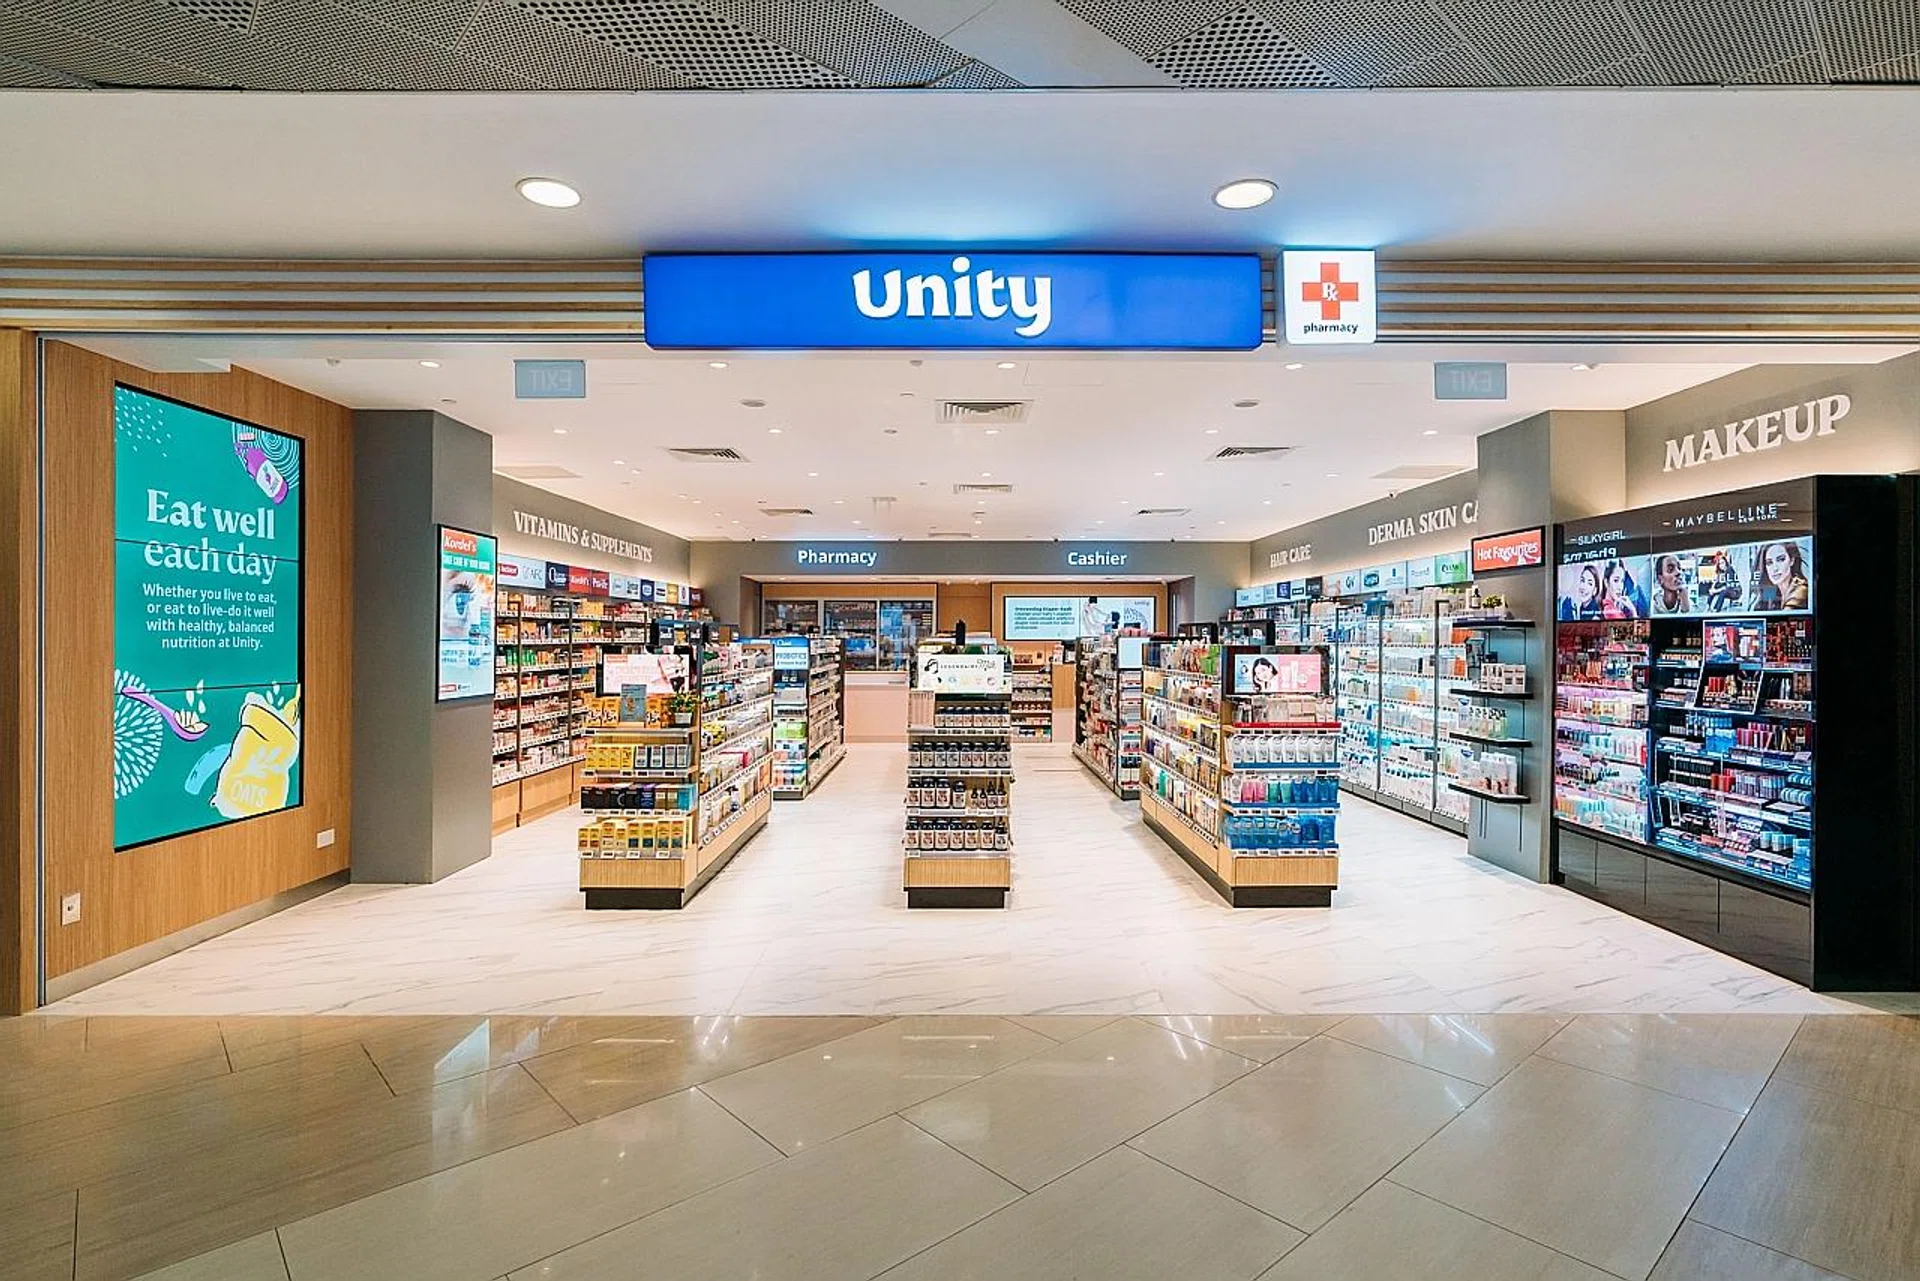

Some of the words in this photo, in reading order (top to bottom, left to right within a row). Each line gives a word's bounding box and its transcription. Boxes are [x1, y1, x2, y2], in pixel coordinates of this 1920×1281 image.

[852, 256, 1052, 337] Unity
[1303, 322, 1359, 334] pharmacy
[1663, 394, 1851, 472] MAKEUP
[146, 488, 207, 529] Eat
[212, 507, 275, 540] well
[1368, 518, 1415, 546] DERMA
[1419, 505, 1458, 534] SKIN
[1675, 503, 1777, 528] MAYBELLINE
[513, 510, 579, 545] VITAMINS
[580, 529, 590, 547] &
[591, 532, 652, 562] SUPPLEMENTS
[1578, 530, 1626, 546] SILKYGIRL
[144, 537, 220, 573] each
[226, 541, 277, 584] day
[797, 550, 877, 567] Pharmacy
[1067, 551, 1127, 566] Cashier
[1270, 552, 1289, 568] HAIR
[1290, 544, 1313, 564] CARE
[1477, 547, 1492, 561] Hot
[143, 583, 198, 598] Whether
[200, 589, 222, 603] you
[224, 588, 243, 601] live
[246, 591, 256, 602] to
[258, 592, 277, 605] eat,
[147, 602, 161, 614] or
[164, 603, 184, 615] eat
[188, 604, 200, 615] to
[244, 605, 252, 617] it
[254, 606, 275, 618] well
[146, 618, 175, 632] with
[178, 619, 226, 635] healthy,
[228, 620, 275, 633] balanced
[162, 636, 216, 649] nutrition
[218, 637, 230, 648] at
[232, 636, 264, 651] Unity.
[230, 779, 268, 807] OATS
